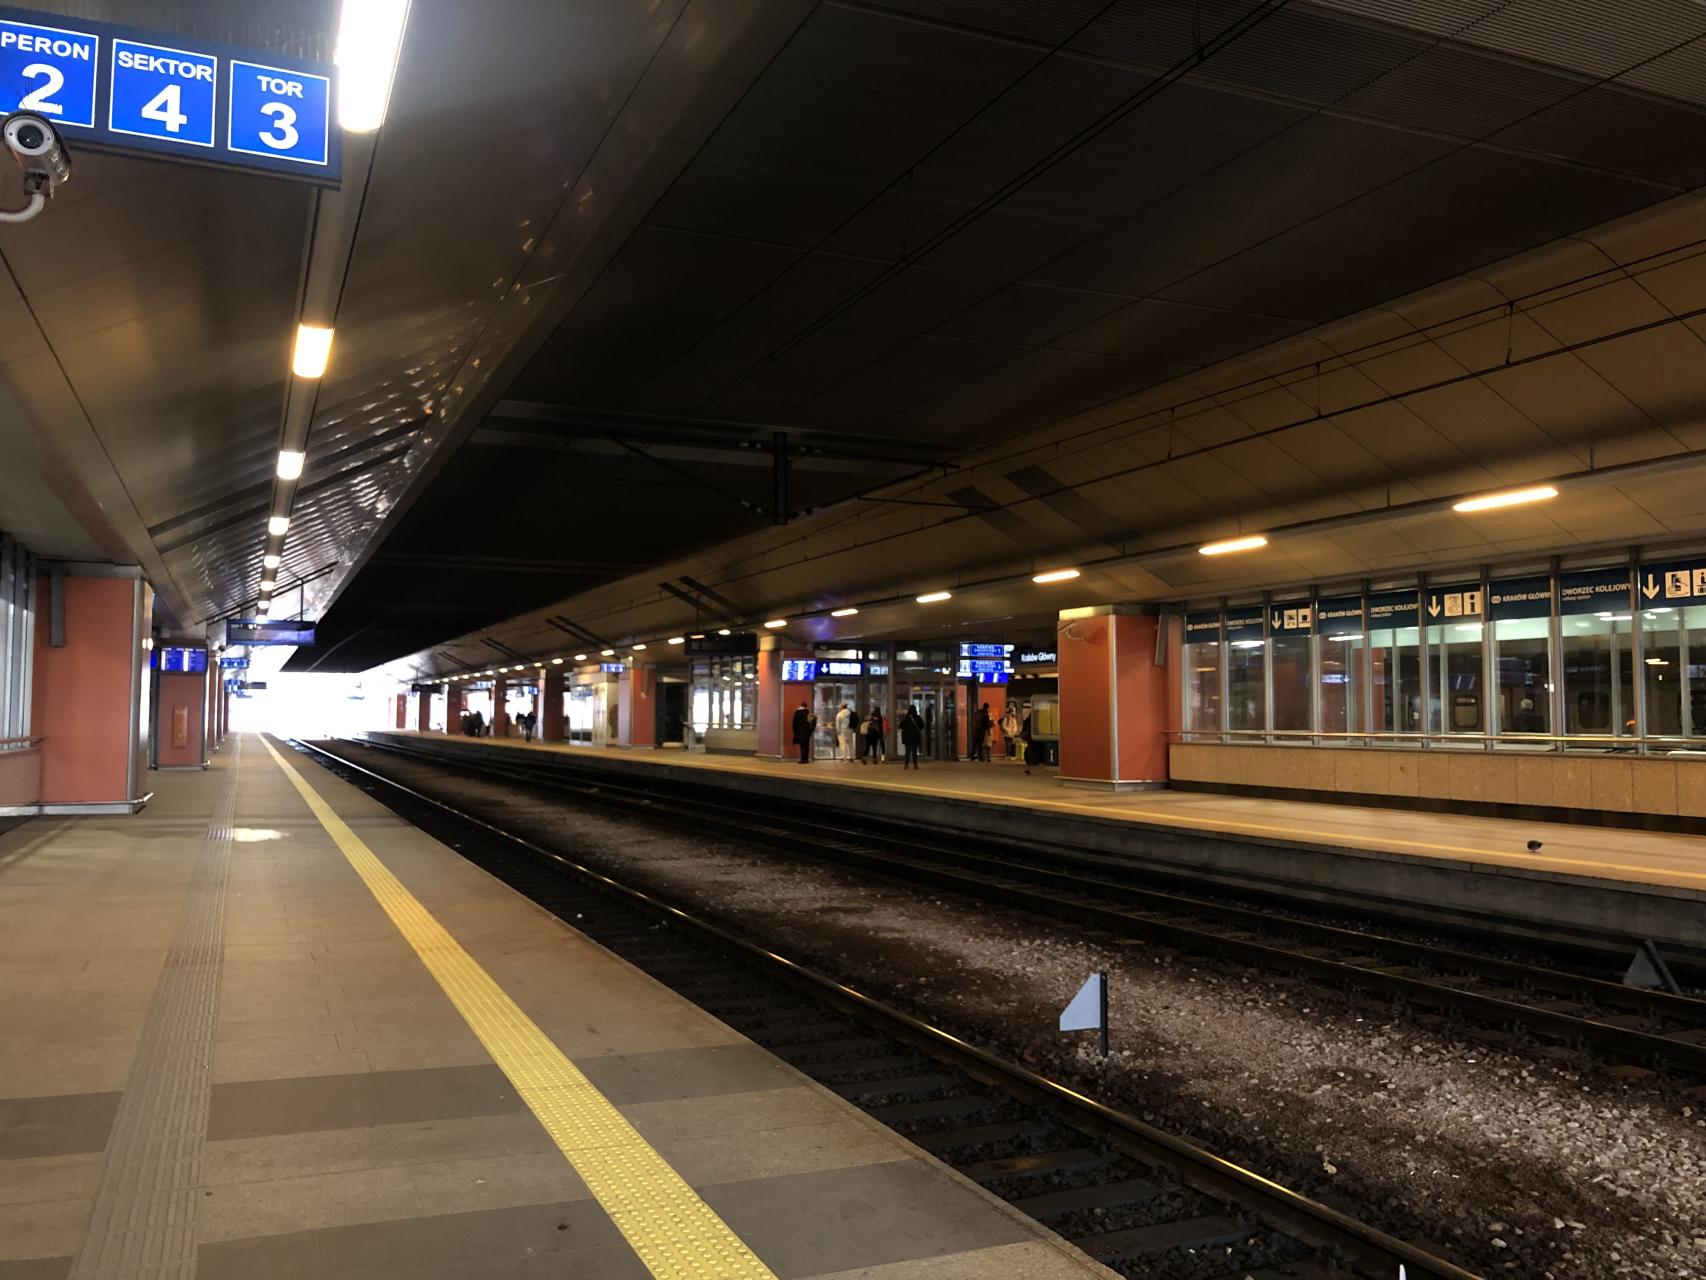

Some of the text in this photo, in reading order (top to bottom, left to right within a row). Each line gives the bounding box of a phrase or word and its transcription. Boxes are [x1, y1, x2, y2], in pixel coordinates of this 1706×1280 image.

[0, 31, 89, 61] PERON
[118, 51, 213, 82] SEKTOR
[18, 63, 64, 115] 2
[257, 75, 304, 99] TOR
[141, 84, 188, 133] 4
[258, 101, 299, 150] 3
[1503, 593, 1527, 602] KRAKÓW
[1562, 586, 1594, 596] DWORZEC
[1371, 605, 1394, 614] DWORZEC
